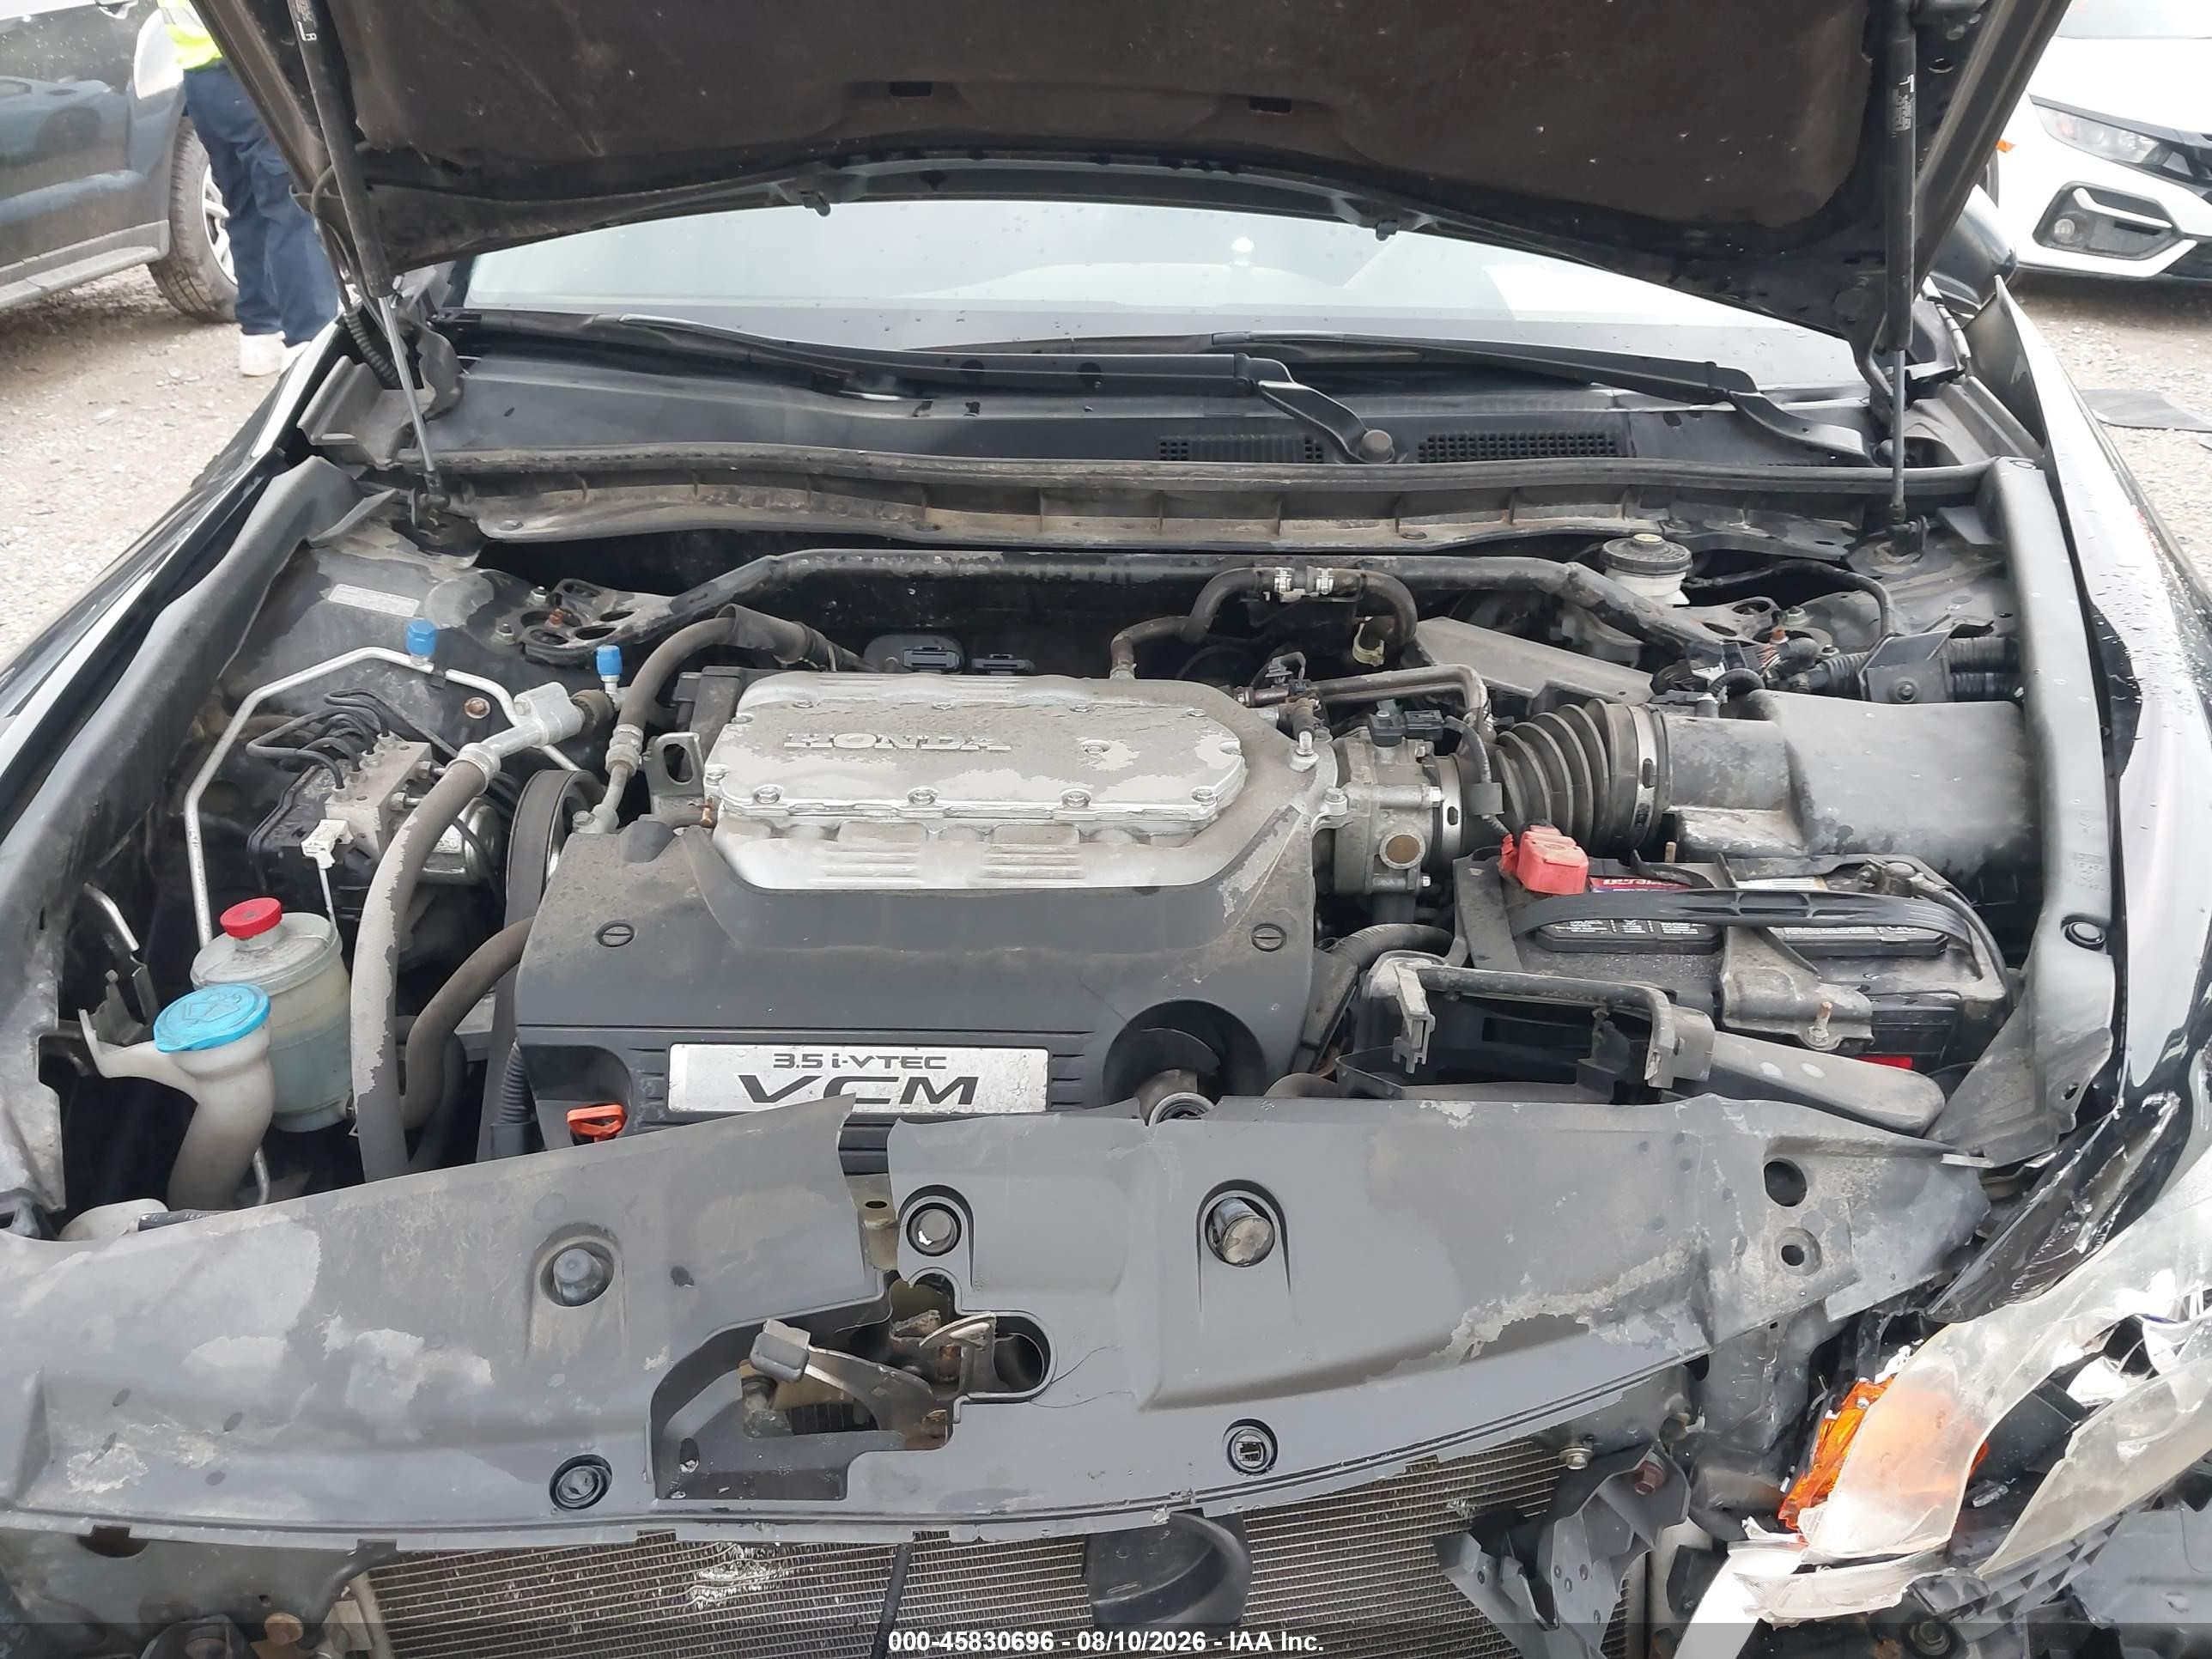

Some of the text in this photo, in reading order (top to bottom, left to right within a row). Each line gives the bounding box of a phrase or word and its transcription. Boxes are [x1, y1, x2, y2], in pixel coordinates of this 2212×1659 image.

[783, 732, 1012, 750] HONDA
[773, 1053, 947, 1070] 3.5 i-VTEC
[738, 1074, 979, 1105] VCM
